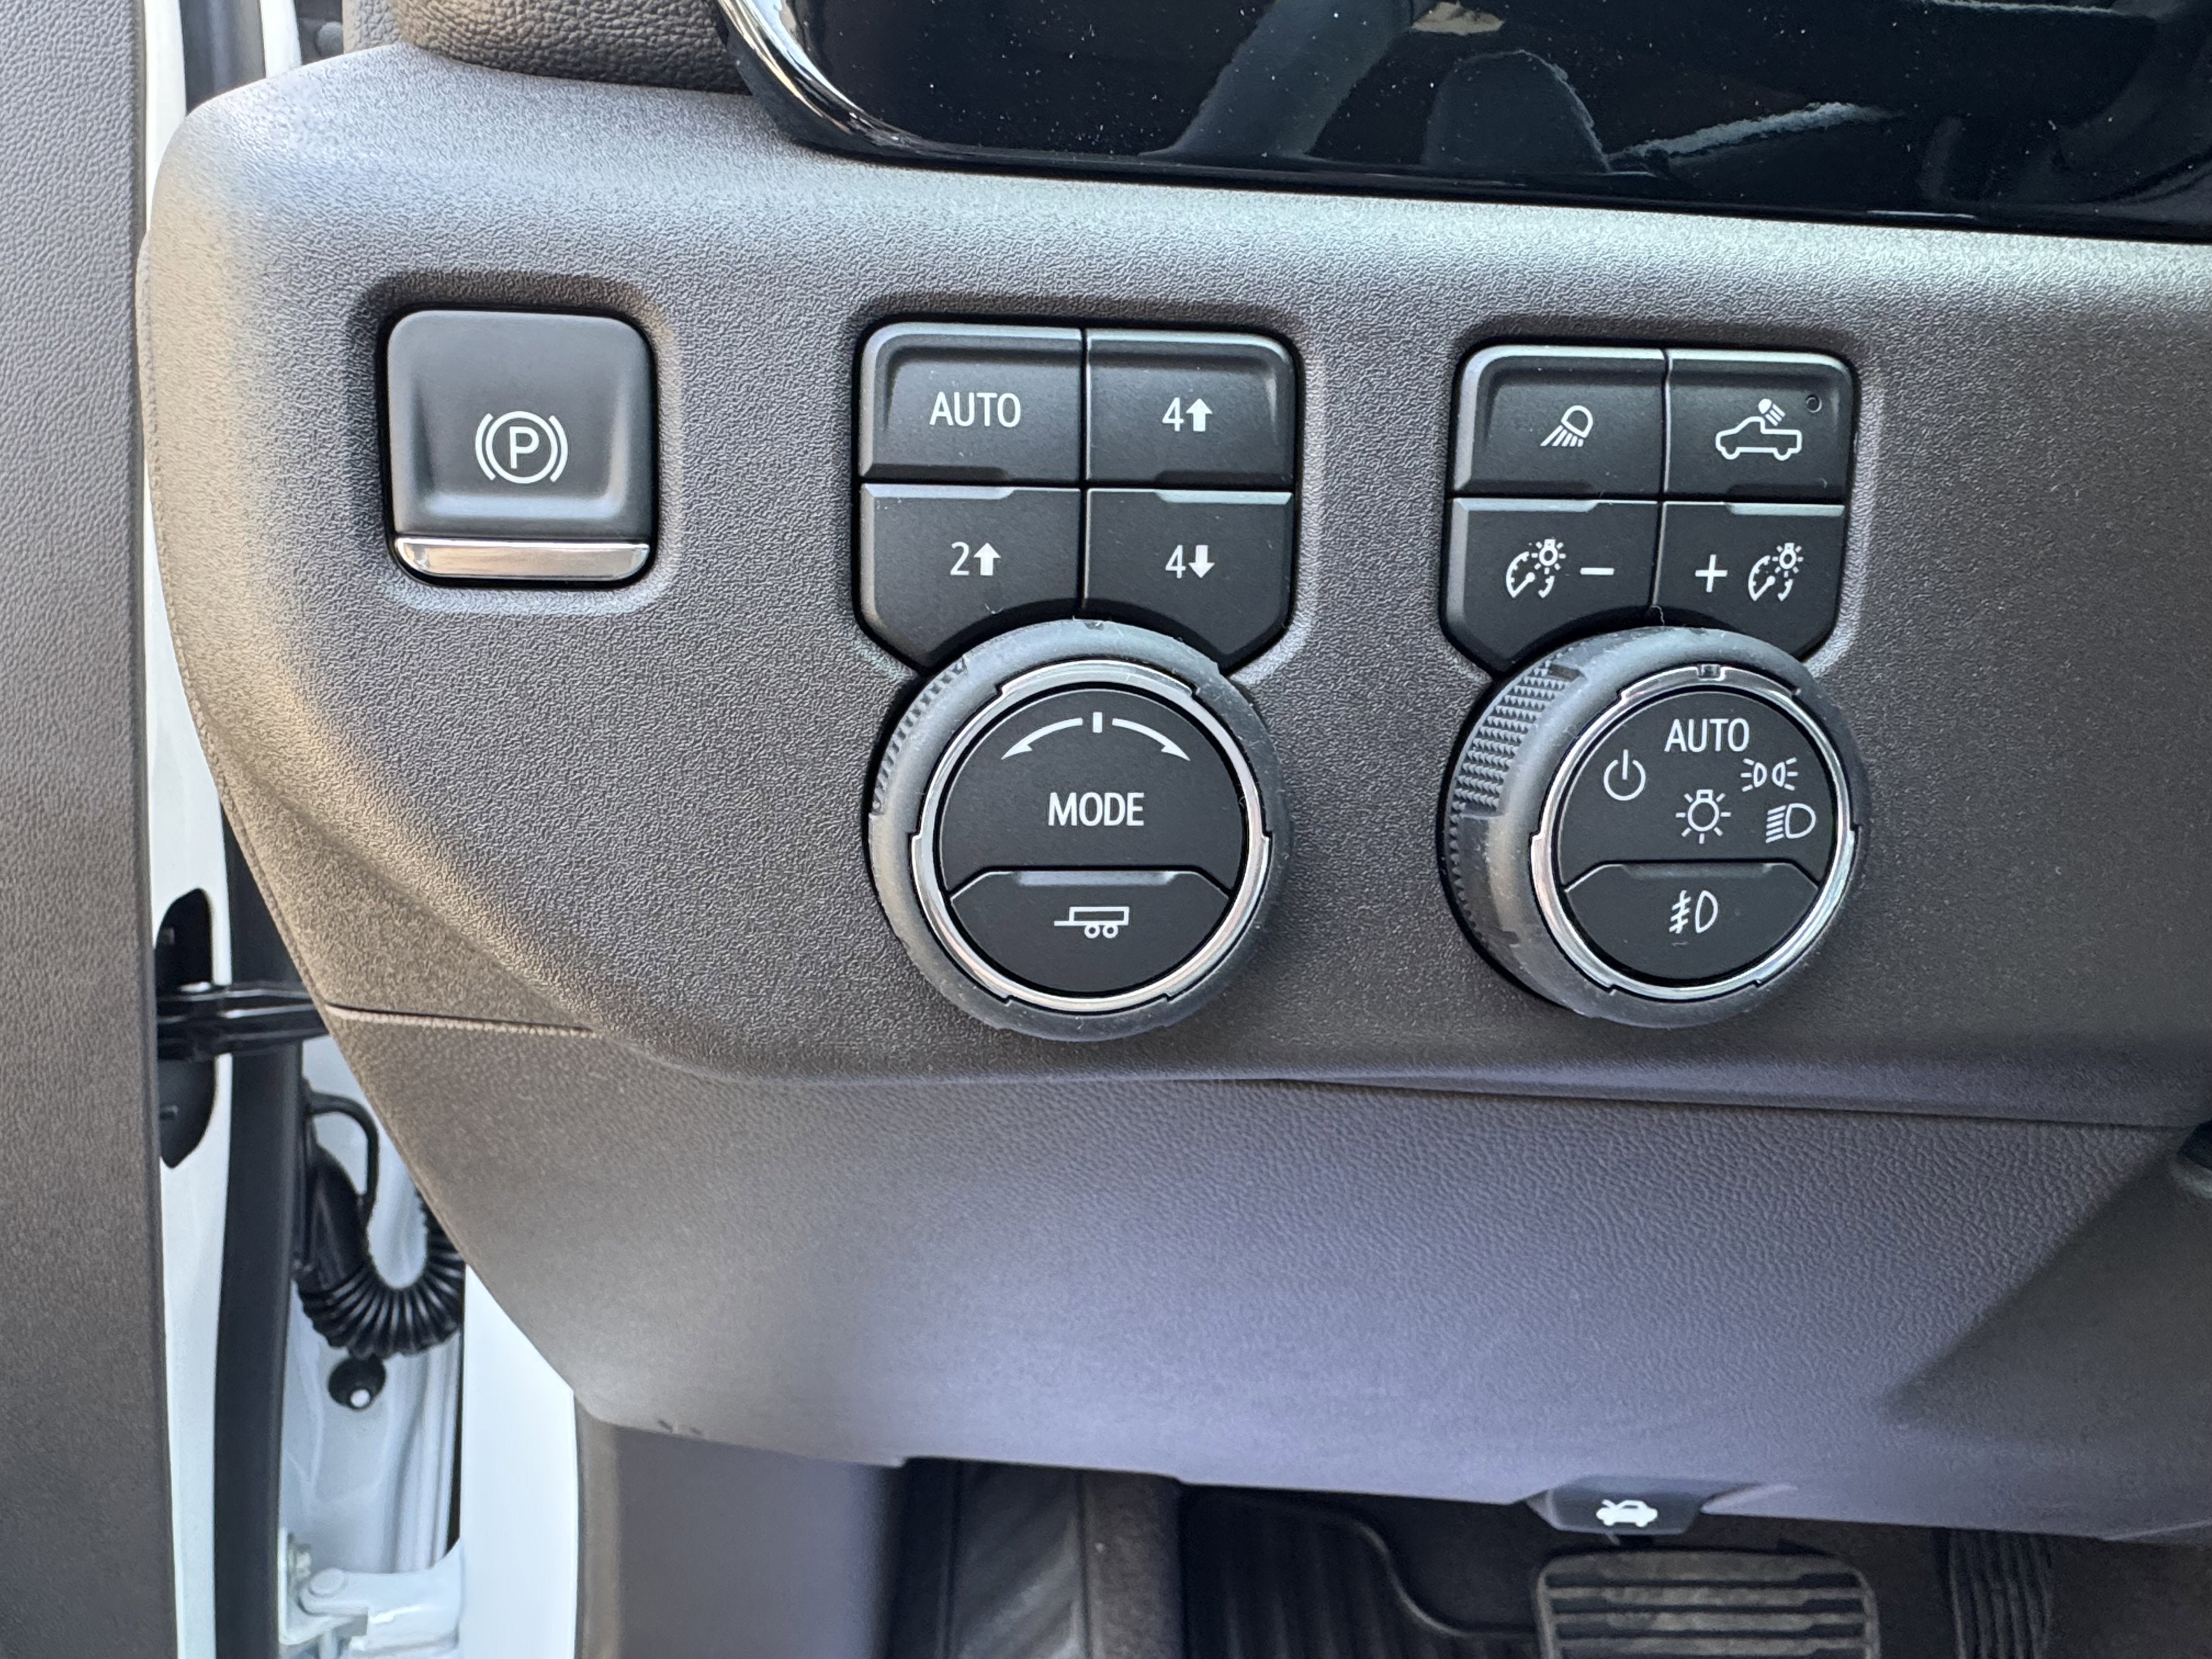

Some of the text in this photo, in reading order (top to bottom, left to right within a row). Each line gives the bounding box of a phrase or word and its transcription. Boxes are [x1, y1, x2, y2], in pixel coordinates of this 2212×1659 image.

[929, 392, 1022, 428] AUTO
[1162, 397, 1184, 432] 4
[508, 425, 540, 470] P
[950, 541, 970, 577] 2
[1165, 544, 1186, 579] 4
[1664, 718, 1750, 753] AUTO
[1047, 792, 1145, 827] MODE
